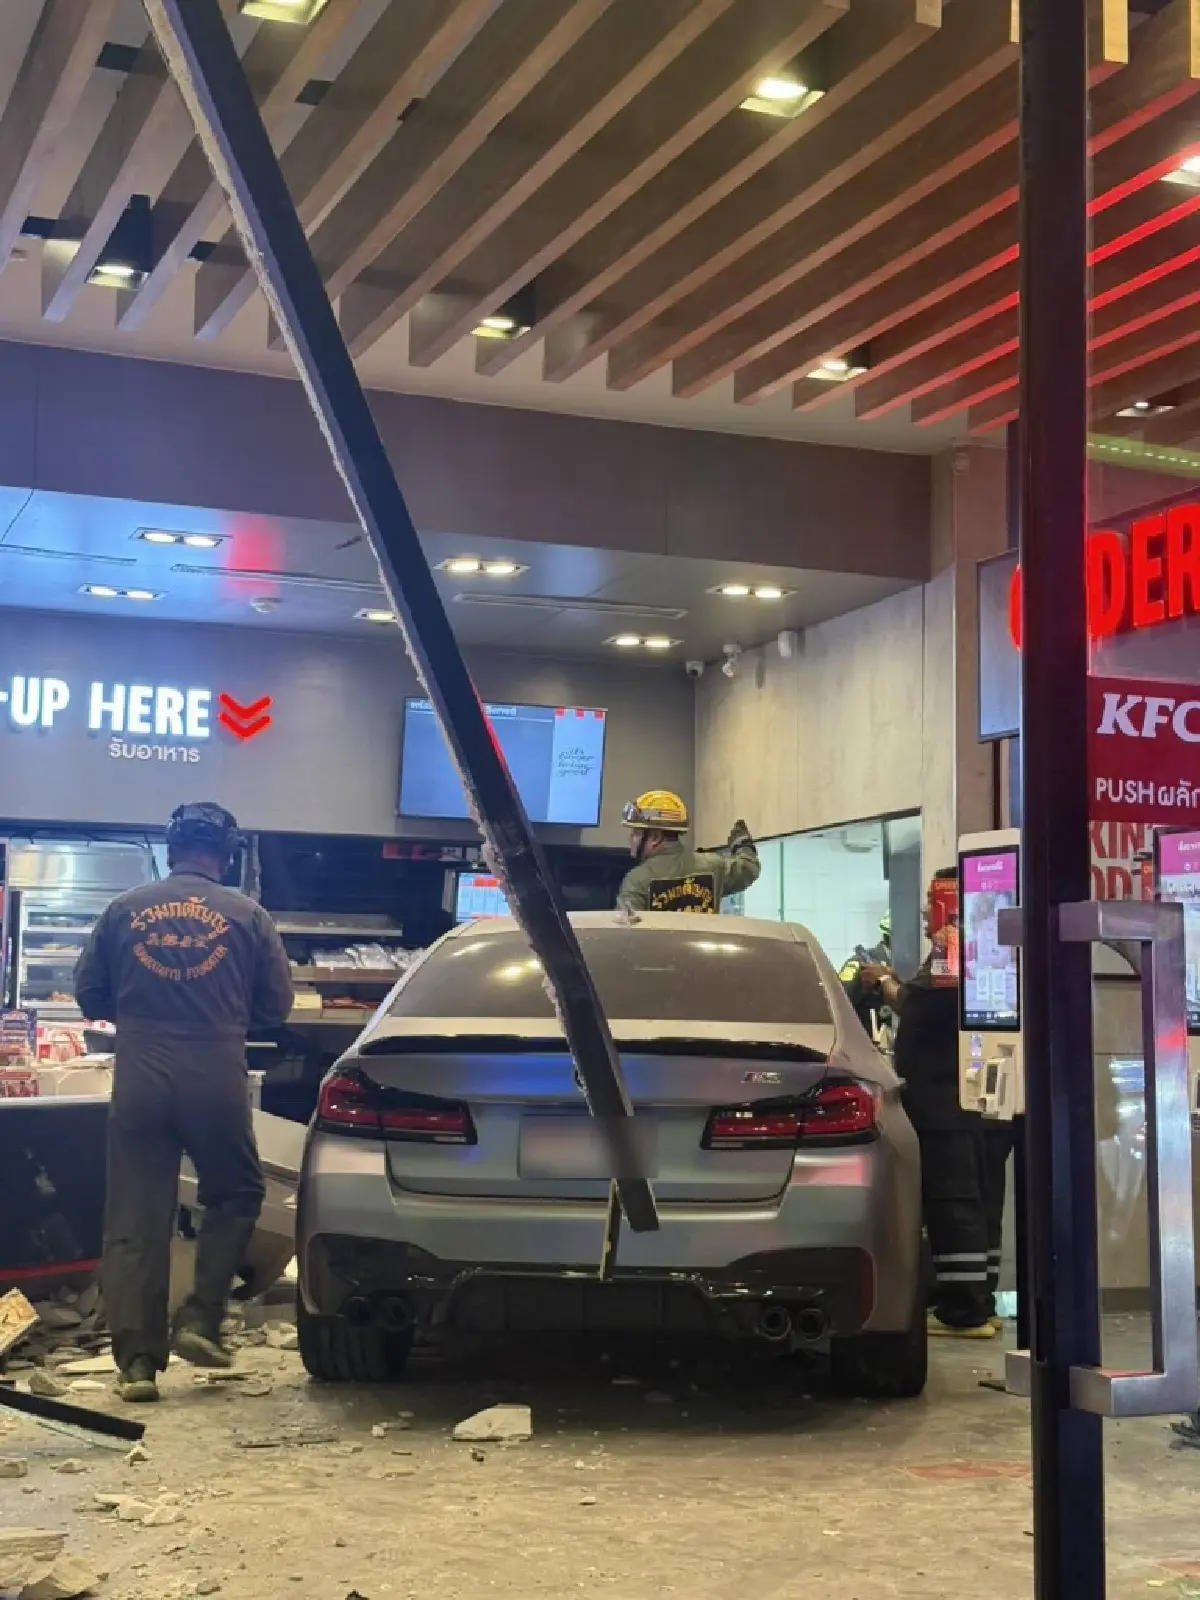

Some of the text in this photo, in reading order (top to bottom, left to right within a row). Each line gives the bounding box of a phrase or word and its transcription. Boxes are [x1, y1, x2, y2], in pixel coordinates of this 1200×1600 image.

[88, 682, 211, 738] HERE
[1095, 692, 1200, 743] KFC
[108, 736, 201, 764] รับอาหาร
[1096, 777, 1154, 806] PUSH
